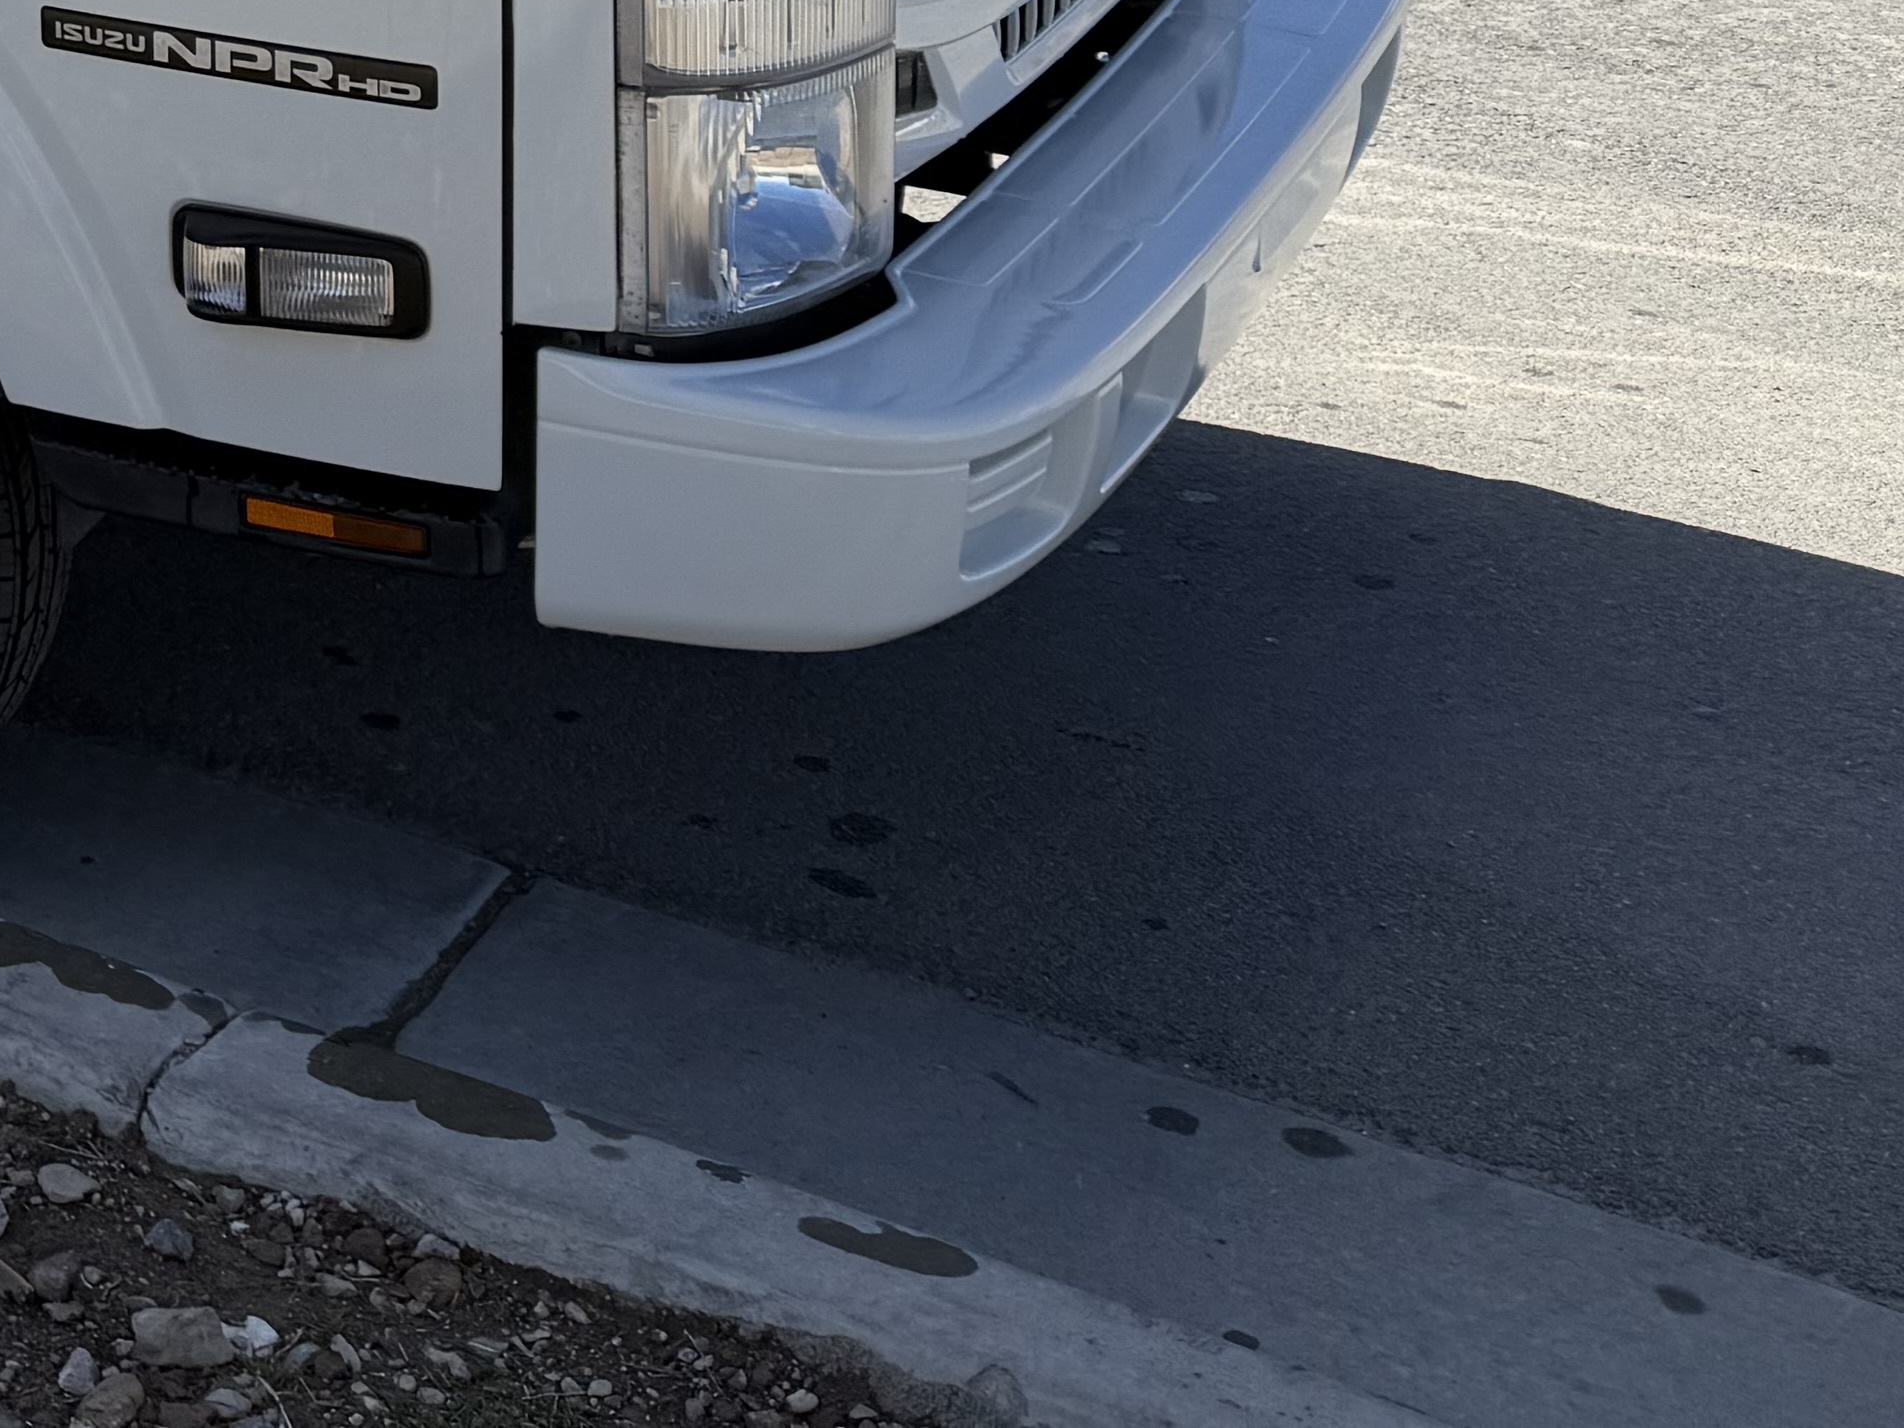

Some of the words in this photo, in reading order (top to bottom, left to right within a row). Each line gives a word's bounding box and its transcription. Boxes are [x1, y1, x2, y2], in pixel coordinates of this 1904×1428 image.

[55, 20, 146, 54] ISUZU
[153, 31, 333, 90] NPR
[338, 74, 422, 102] HD
